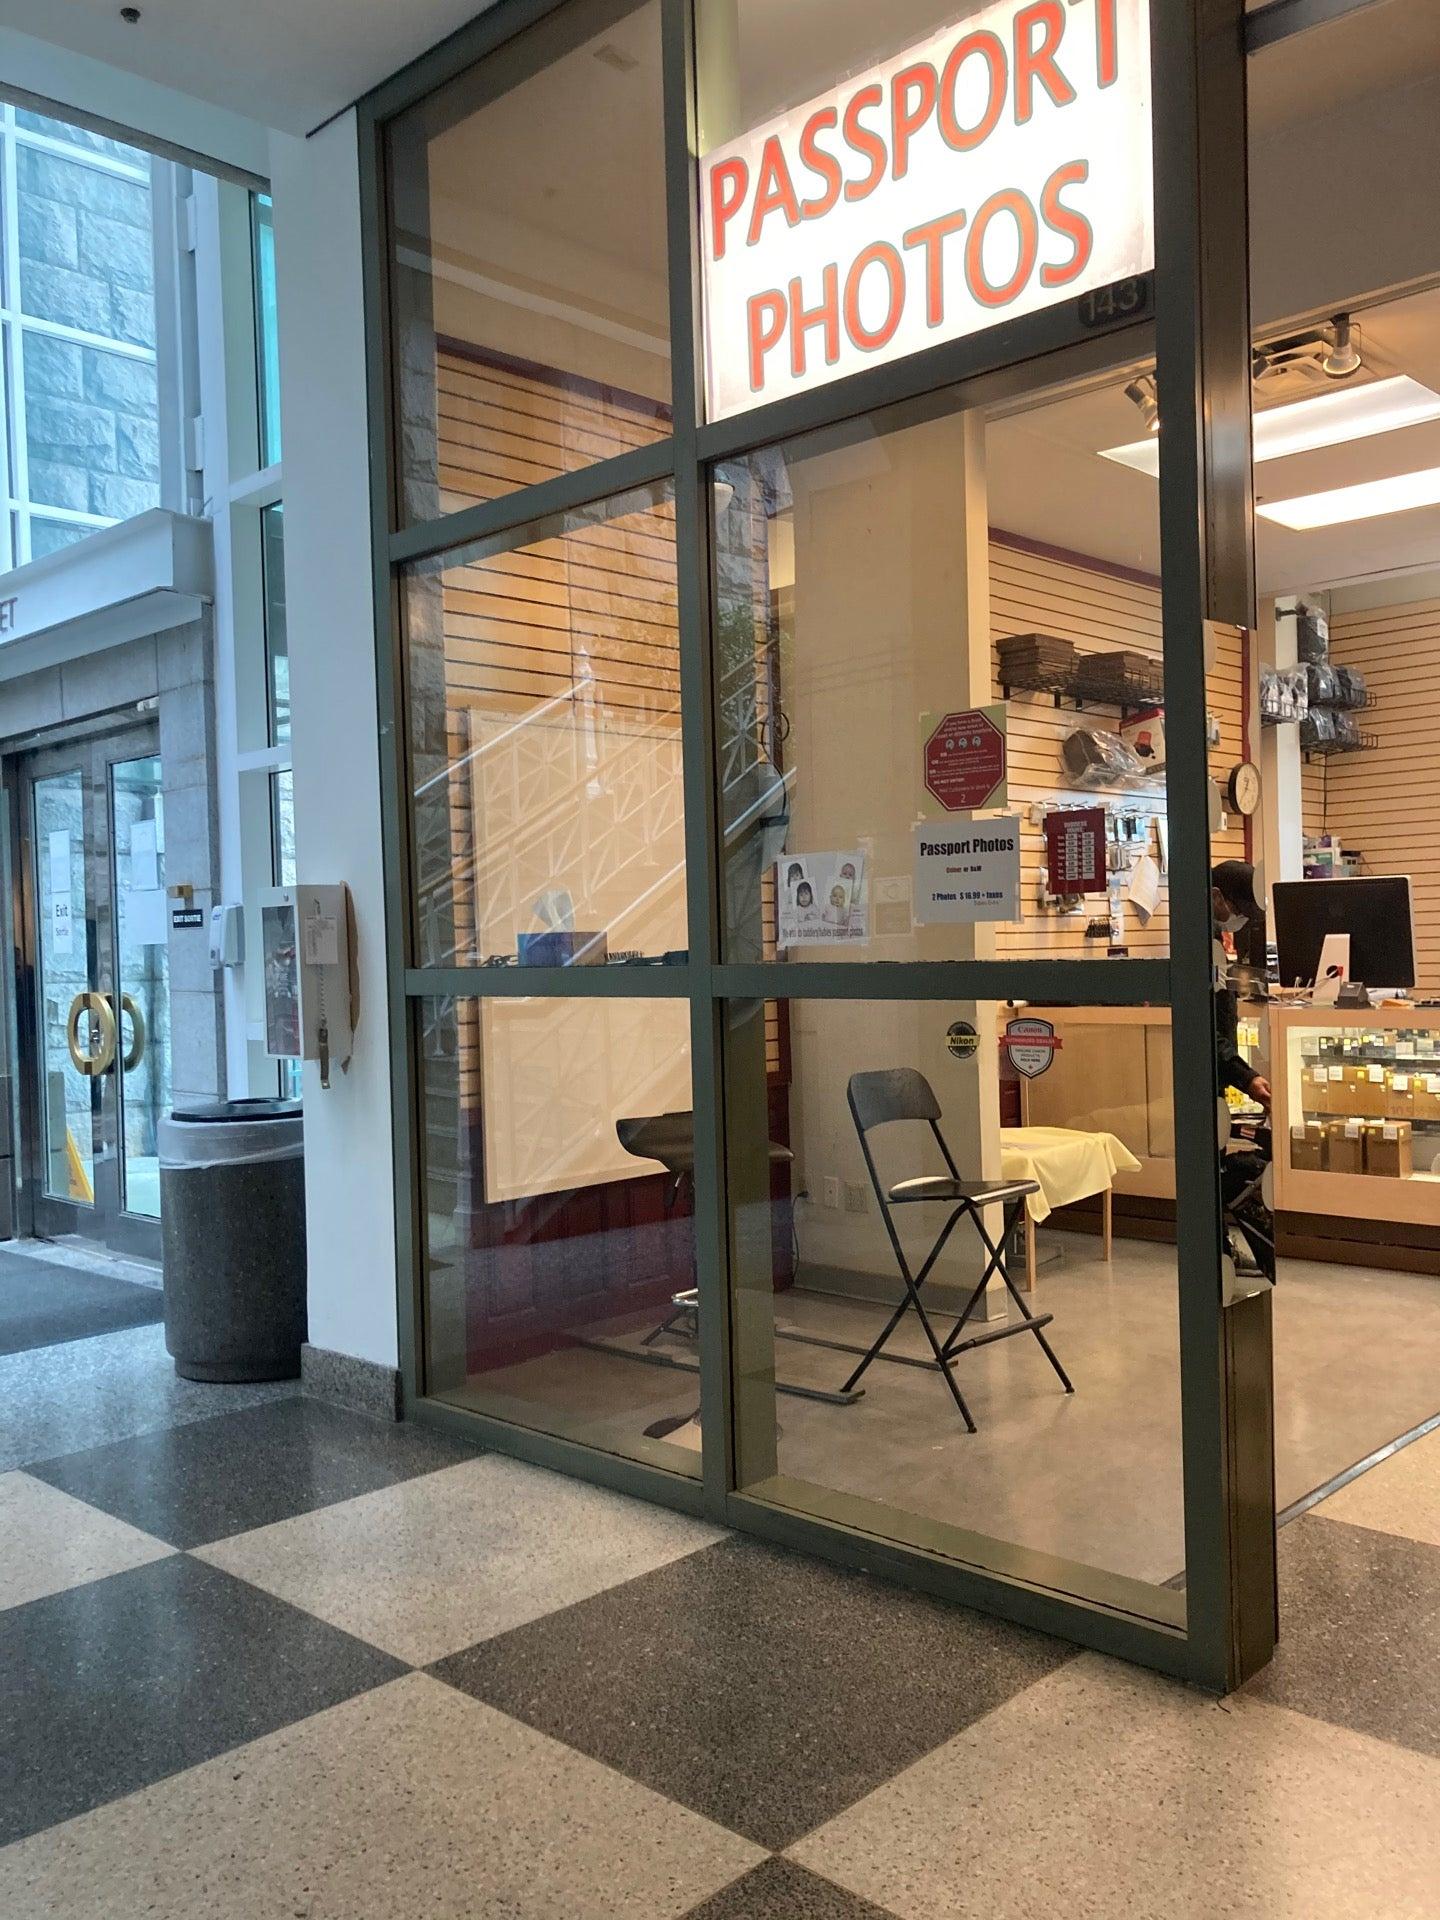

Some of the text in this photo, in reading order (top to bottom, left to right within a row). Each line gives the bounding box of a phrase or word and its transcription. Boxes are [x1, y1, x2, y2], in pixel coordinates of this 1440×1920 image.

[709, 0, 1119, 261] PASSPORT
[747, 159, 1093, 392] PHOTOS
[1083, 279, 1138, 321] 143
[961, 795, 966, 803] 2
[920, 838, 1014, 856] Passport Photos
[937, 892, 957, 901] Photos
[965, 891, 981, 900] 16.99
[56, 904, 69, 918] Exit
[173, 915, 185, 923] EXIT
[1018, 1025, 1043, 1034] Canon
[950, 1036, 974, 1045] Nikon
